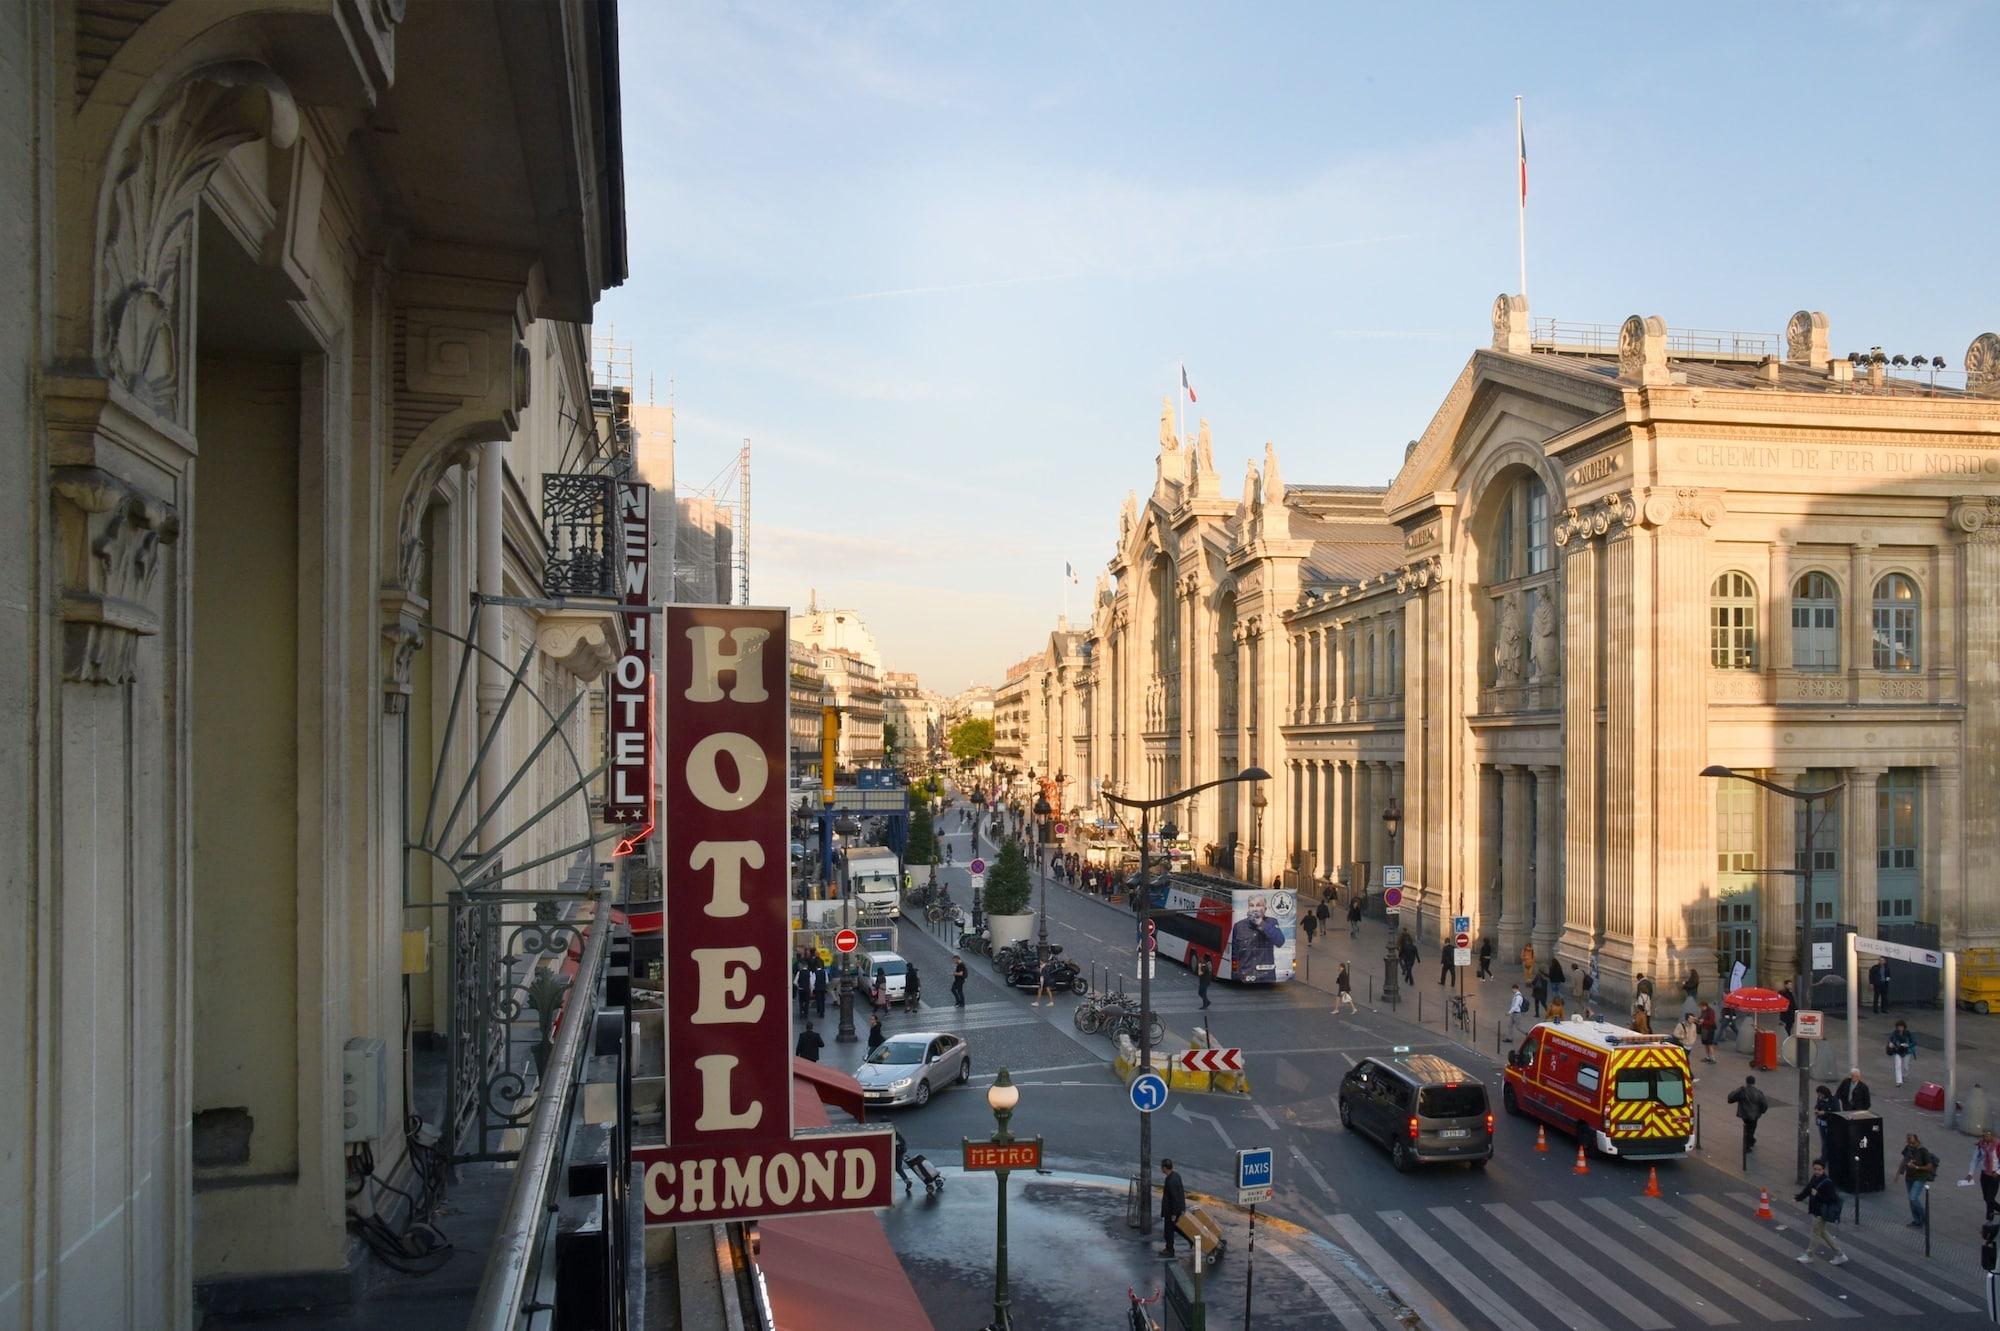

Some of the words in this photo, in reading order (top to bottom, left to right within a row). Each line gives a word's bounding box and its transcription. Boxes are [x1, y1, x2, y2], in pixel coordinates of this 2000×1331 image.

[1696, 444, 1783, 468] CHEMIN
[1791, 448, 1819, 471] DE
[1831, 450, 1875, 472] FER
[1886, 452, 1914, 473] DU
[1925, 454, 1982, 475] NORD
[620, 484, 647, 594] NEW
[684, 626, 770, 1131] HOTEL
[971, 1148, 1034, 1165] METRO
[1244, 1162, 1269, 1176] TAXIS
